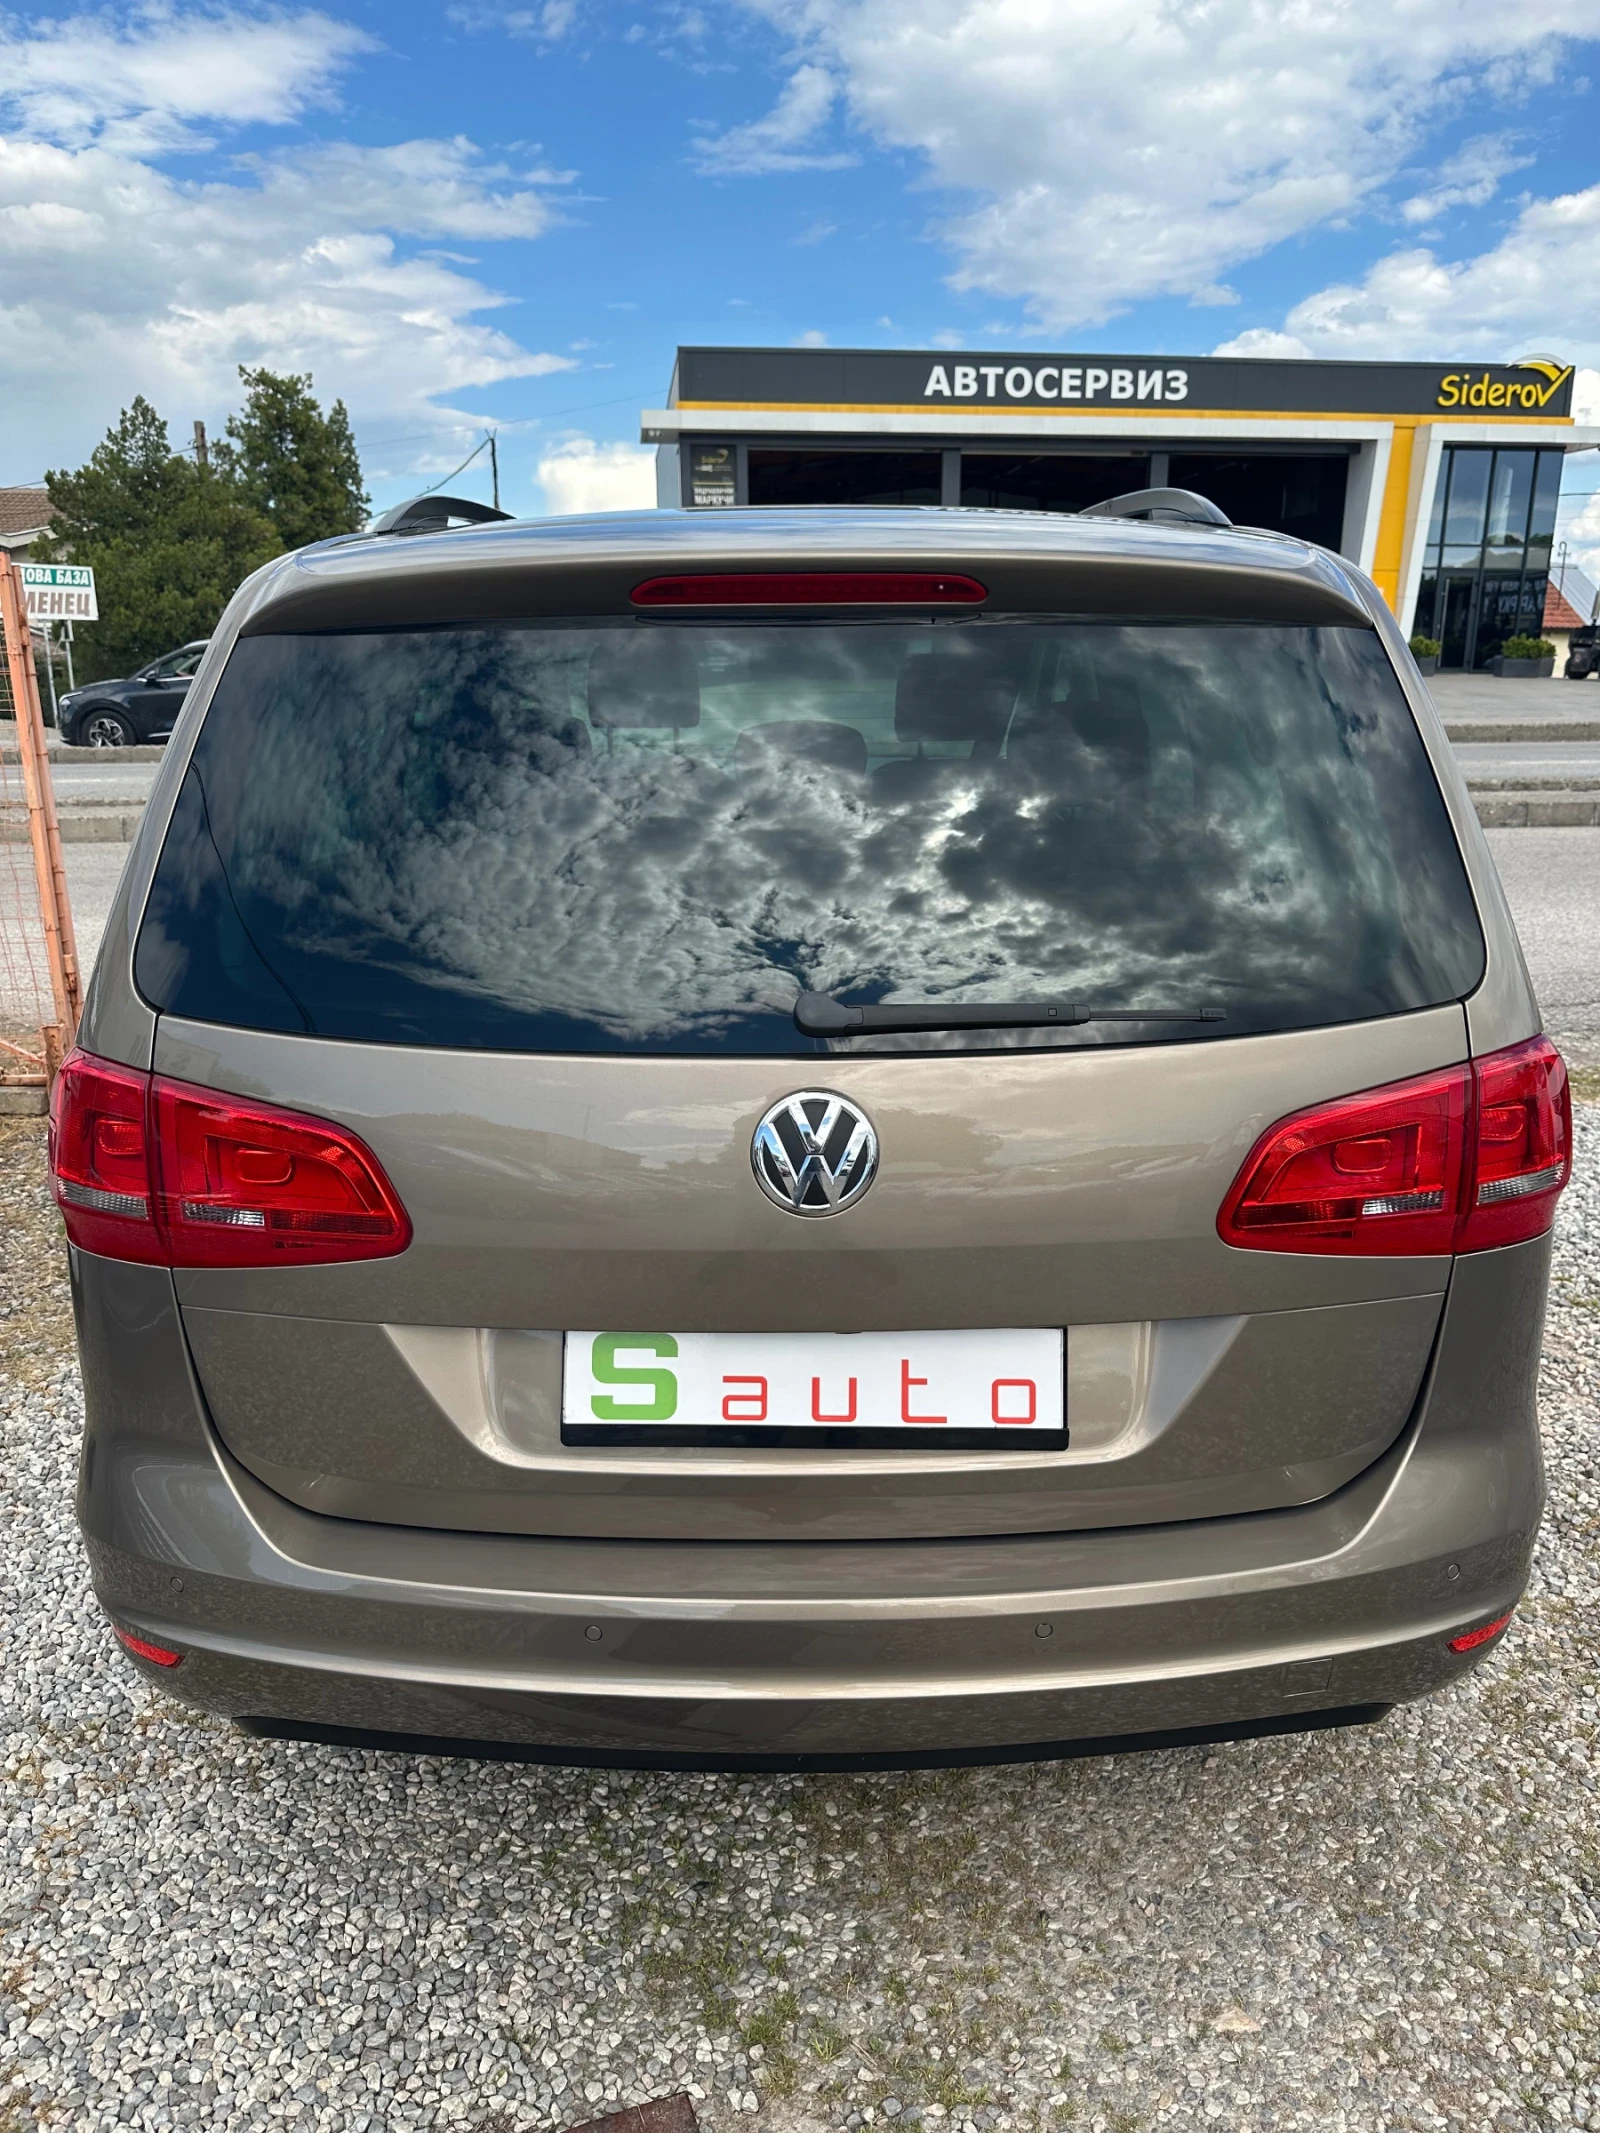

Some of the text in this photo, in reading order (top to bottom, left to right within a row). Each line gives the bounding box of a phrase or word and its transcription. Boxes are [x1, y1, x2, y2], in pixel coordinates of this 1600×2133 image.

[924, 365, 1189, 401] АВТОСЕРВИЗ
[1437, 365, 1573, 408] Siderov
[56, 569, 89, 585] БАЗА
[752, 1089, 878, 1215] VW
[590, 1332, 1037, 1424] S auto
